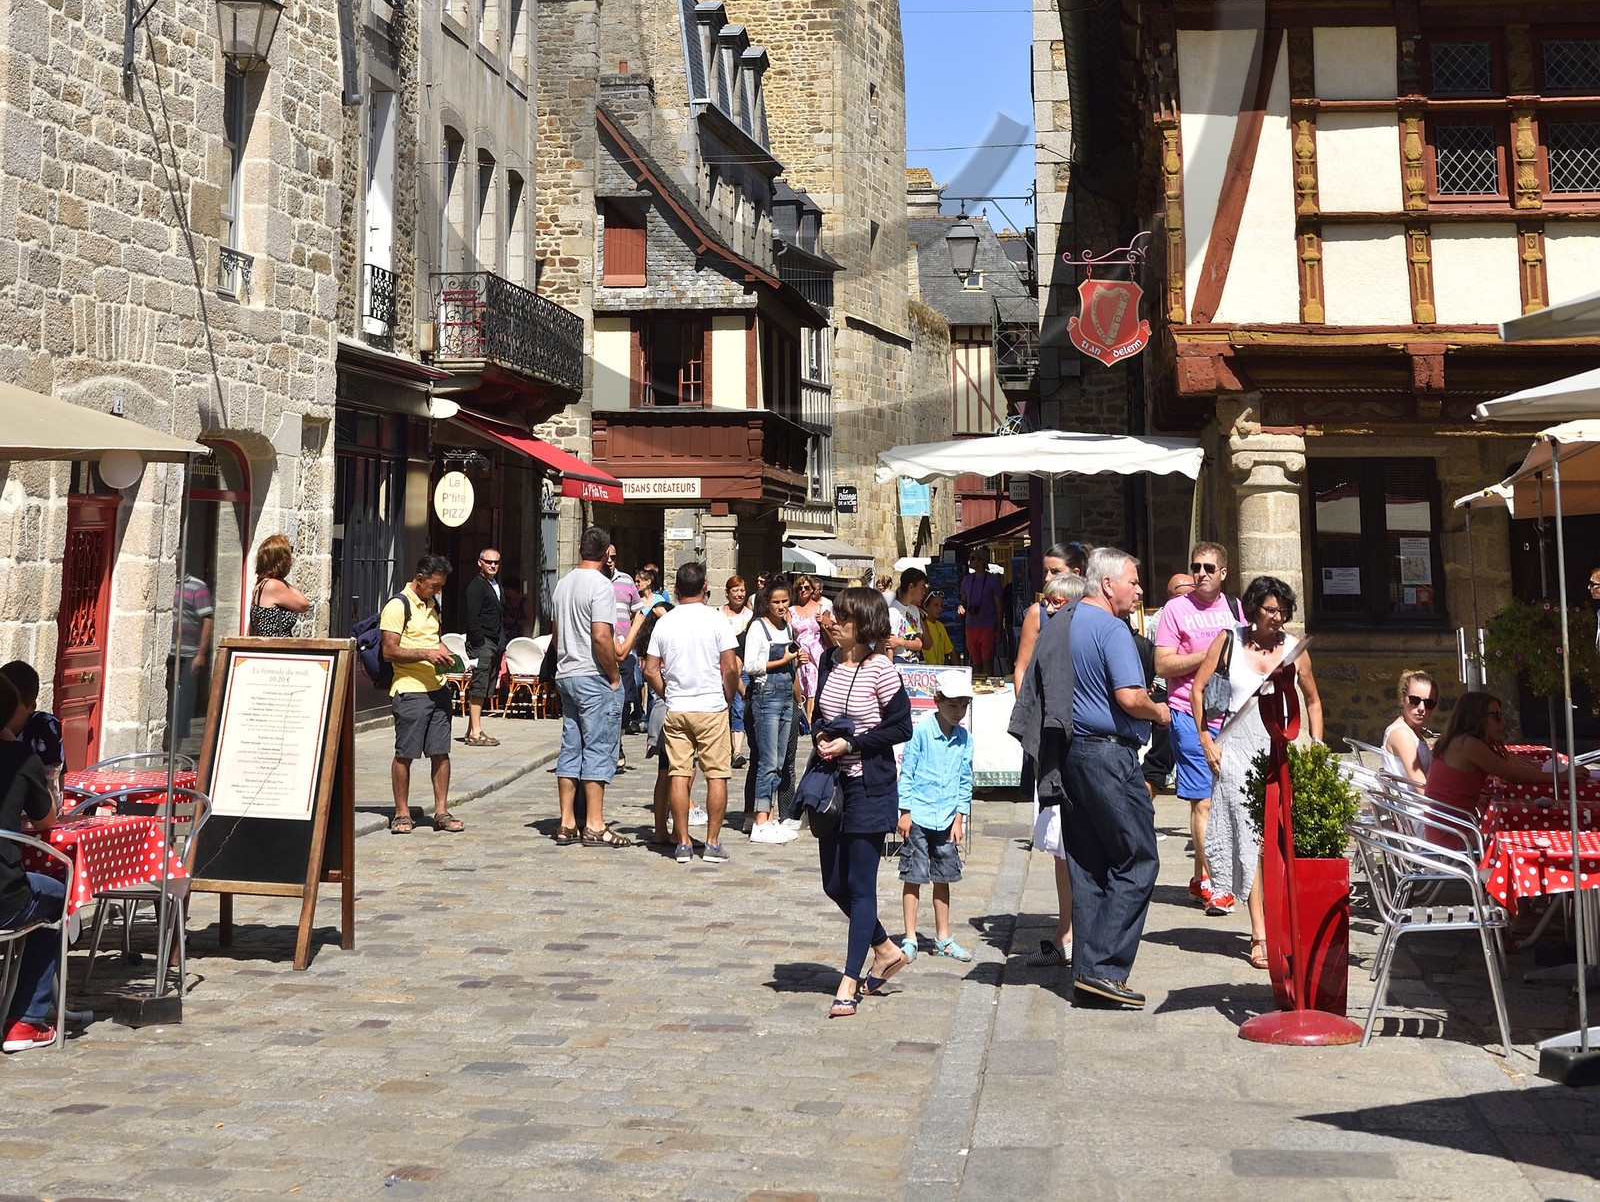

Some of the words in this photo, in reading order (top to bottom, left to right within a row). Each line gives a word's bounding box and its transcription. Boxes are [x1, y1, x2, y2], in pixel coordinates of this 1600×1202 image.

[1089, 346, 1102, 356] an
[1113, 339, 1143, 358] delenn
[449, 478, 460, 488] La
[624, 482, 651, 493] TISANS
[652, 480, 697, 493] CRÉATEURS
[442, 492, 467, 503] P'tite
[1184, 611, 1233, 630] HOLLIST
[252, 666, 260, 674] La
[261, 666, 284, 675] formule
[286, 667, 294, 676] du
[295, 669, 309, 677] midi
[286, 676, 292, 684] €
